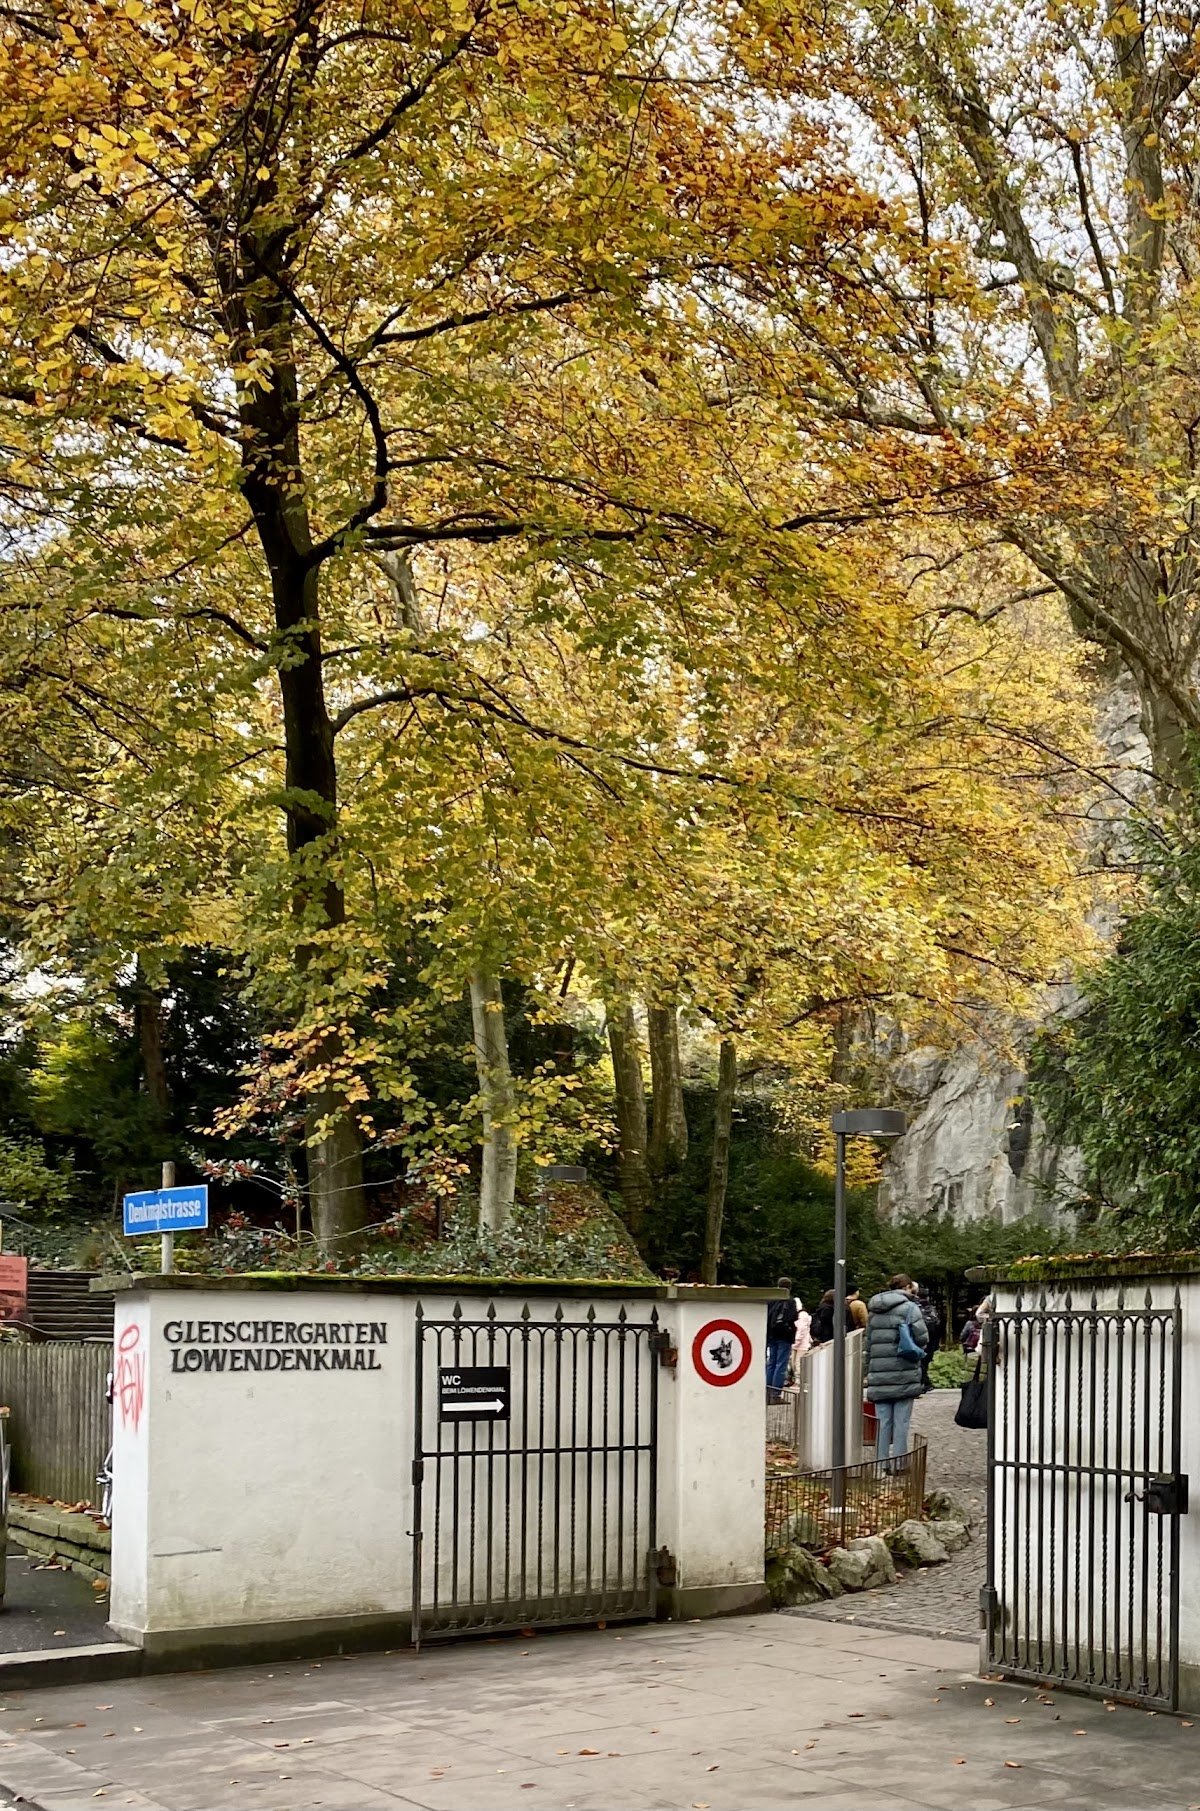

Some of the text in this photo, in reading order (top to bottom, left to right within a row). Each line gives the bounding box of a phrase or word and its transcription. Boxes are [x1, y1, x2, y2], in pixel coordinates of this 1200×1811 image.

[128, 1199, 202, 1224] Denkmalstrasse
[163, 1320, 387, 1344] GLETSCHERGARTEN
[441, 1375, 461, 1386] WC
